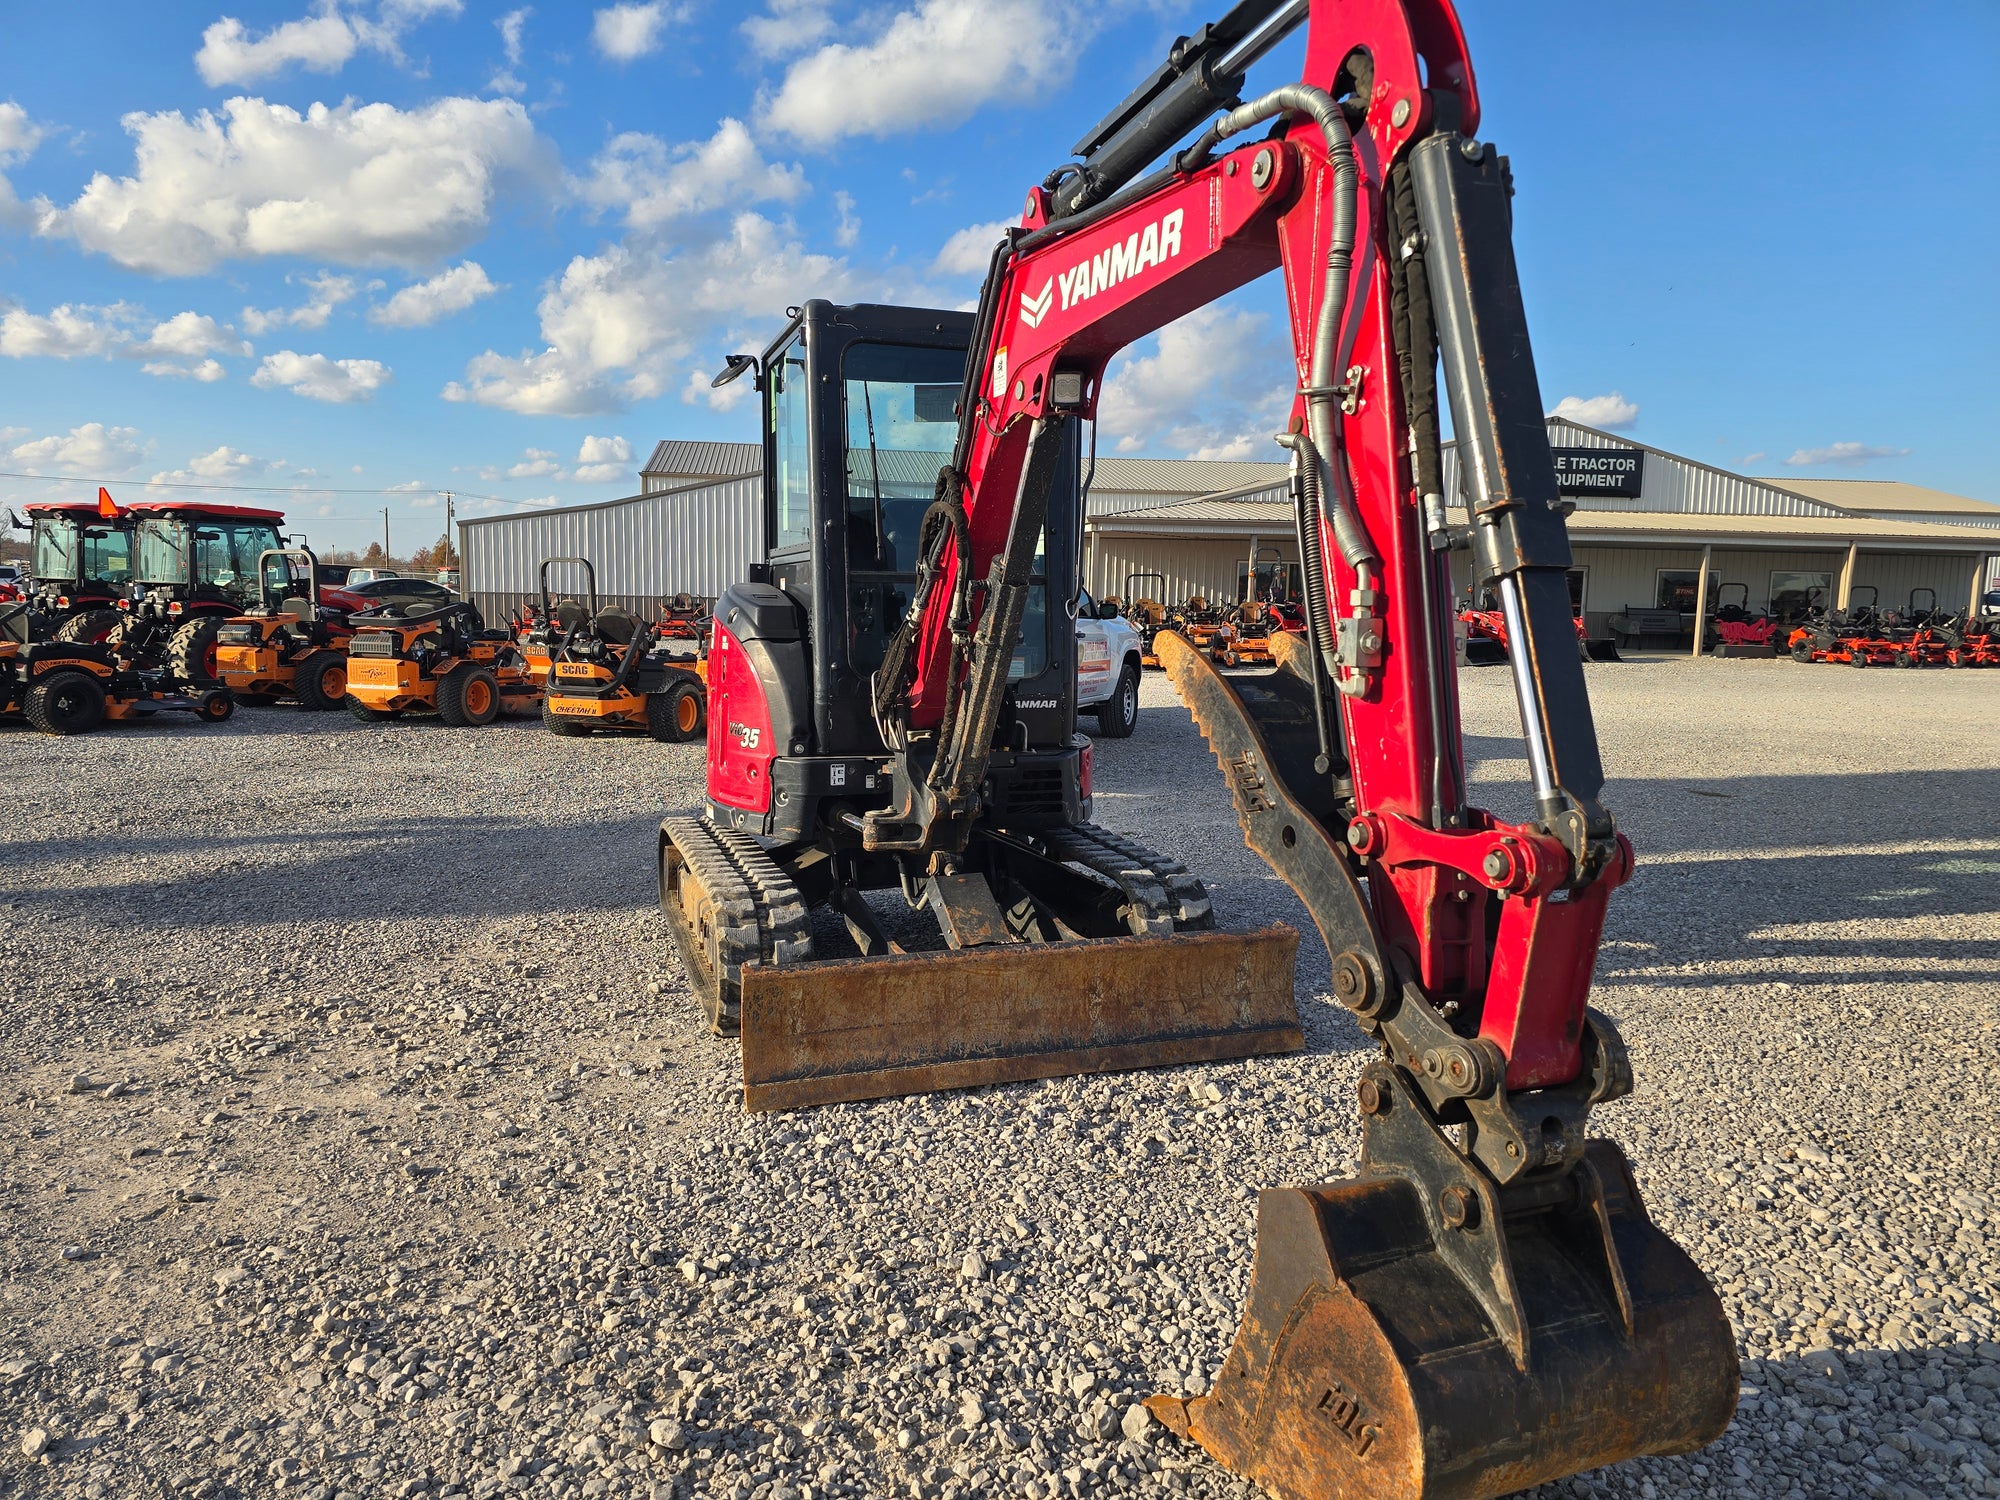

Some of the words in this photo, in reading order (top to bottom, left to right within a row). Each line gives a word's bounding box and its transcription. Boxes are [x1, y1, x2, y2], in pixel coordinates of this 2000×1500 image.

[1057, 207, 1184, 311] YANMAR
[1553, 456, 1567, 470] E
[1570, 457, 1636, 471] TRACTOR
[1555, 473, 1625, 487] QUIPMENT
[526, 646, 546, 655] SCAG
[561, 665, 589, 675] SCAG
[1015, 700, 1058, 709] ANMAR
[555, 705, 591, 715] CHEETAH
